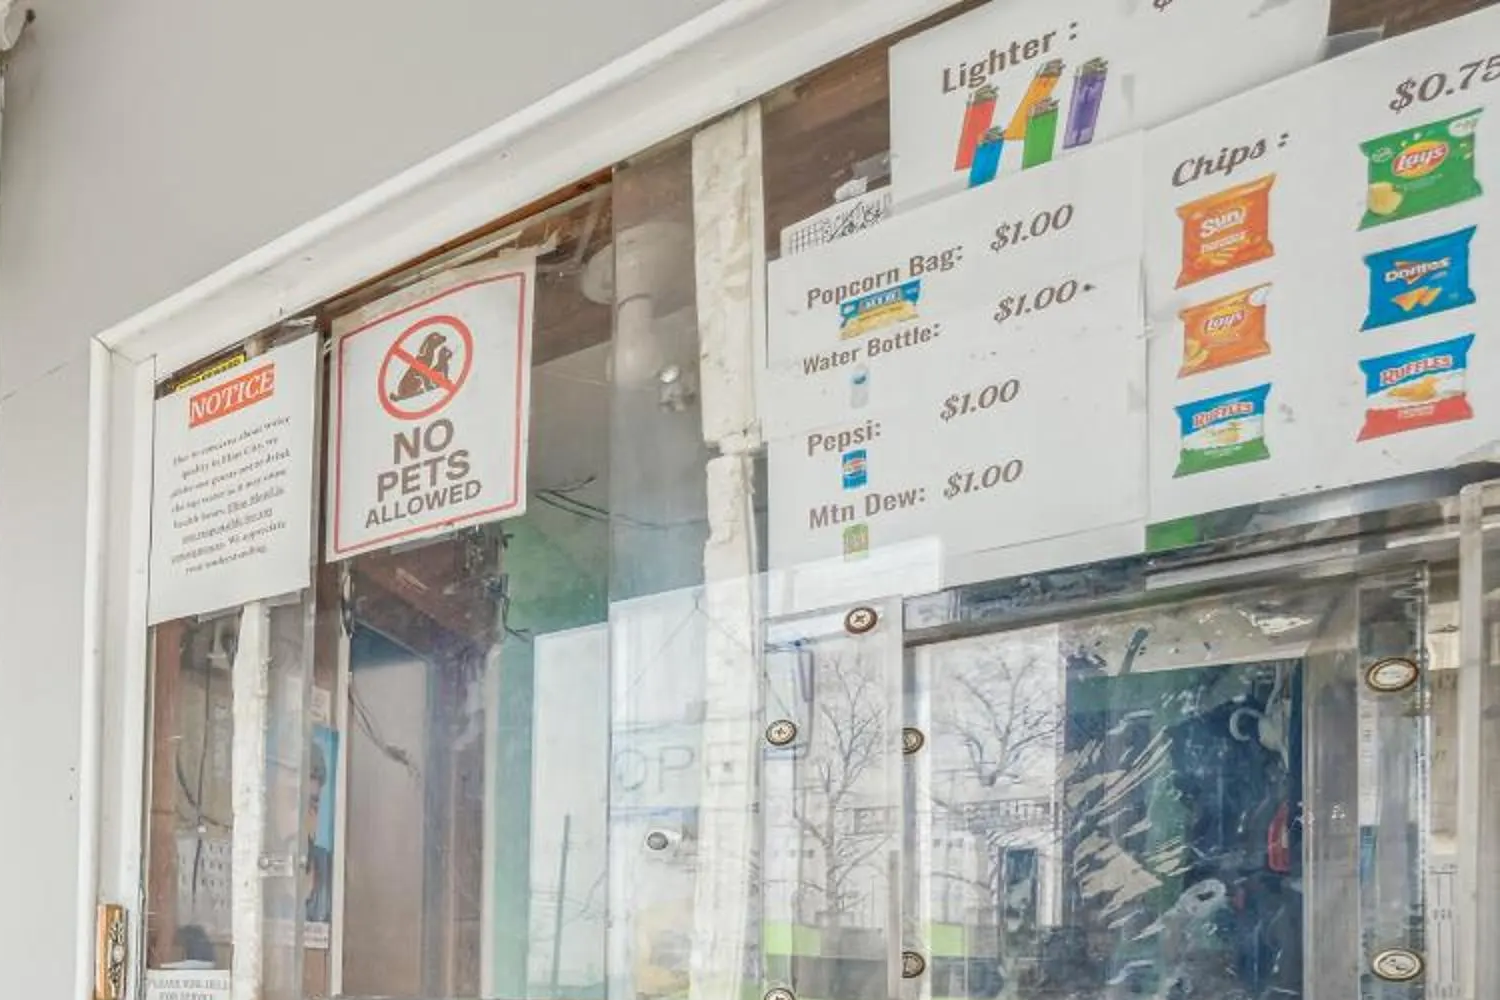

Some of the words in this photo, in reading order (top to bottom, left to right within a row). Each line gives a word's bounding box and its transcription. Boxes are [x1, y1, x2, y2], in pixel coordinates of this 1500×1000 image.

[941, 30, 1056, 94] Lighter
[1389, 54, 1500, 113] $0.75
[1171, 137, 1267, 187] Chips
[807, 267, 900, 309] Popcorn
[909, 245, 963, 276] Bag:
[991, 203, 1074, 252] $1.00
[803, 346, 861, 375] Water
[868, 323, 940, 356] Bottle:
[994, 280, 1078, 323] $1.00
[190, 369, 275, 423] NOTICE
[1380, 354, 1453, 386] RUFFLES
[393, 418, 454, 465] NO
[807, 420, 881, 457] Pepsi:
[940, 379, 1020, 422] $1.00
[365, 479, 482, 528] ALLOWED
[377, 449, 470, 503] PETS
[809, 504, 855, 530] Mtn
[865, 488, 925, 516] Dew:
[943, 459, 1023, 500] $1.00
